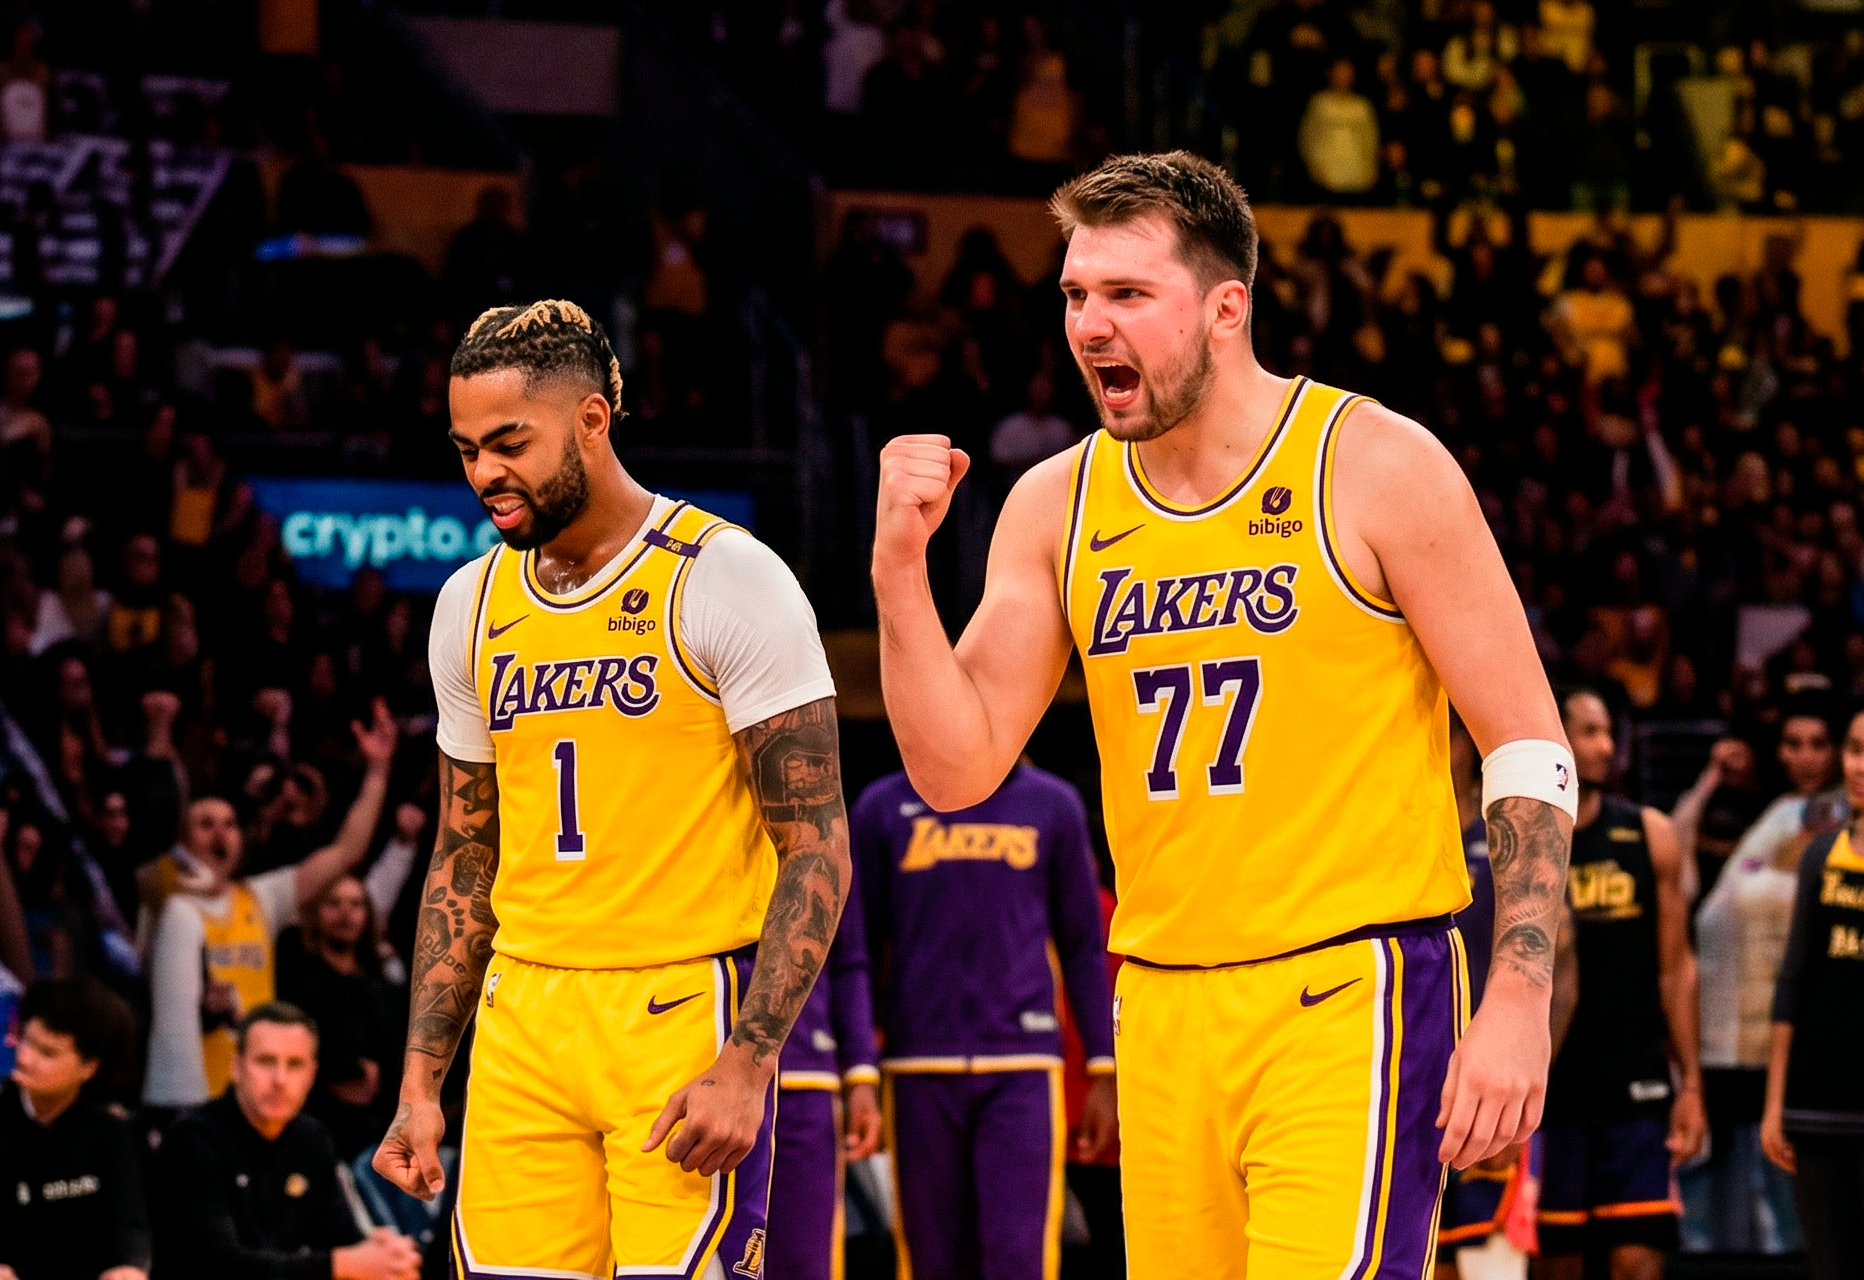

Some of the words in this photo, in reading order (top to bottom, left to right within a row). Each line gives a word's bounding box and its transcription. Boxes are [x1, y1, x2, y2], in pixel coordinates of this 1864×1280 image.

[1248, 517, 1303, 538] bibigo
[607, 615, 656, 635] bibigo
[1087, 562, 1301, 658] LAKERS
[489, 651, 662, 732] LAKERS
[1130, 655, 1264, 802] 77
[552, 738, 587, 861] 1
[900, 816, 1039, 873] LAKERS
